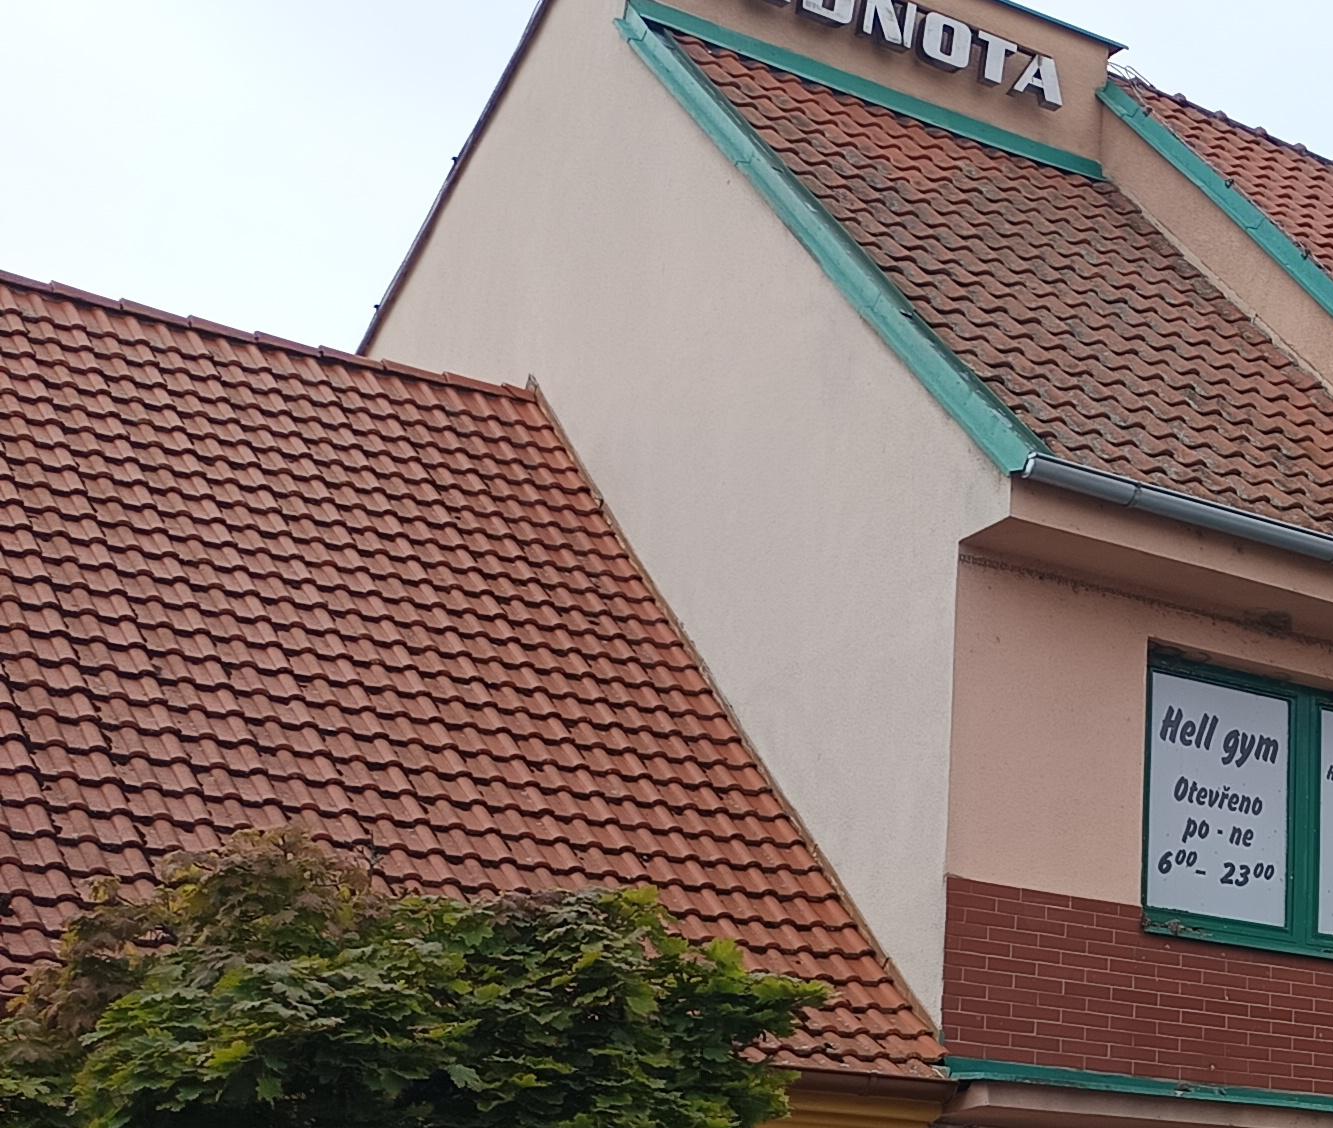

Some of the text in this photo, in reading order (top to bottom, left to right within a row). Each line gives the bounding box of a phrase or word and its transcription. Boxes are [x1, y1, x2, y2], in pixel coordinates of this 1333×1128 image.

[785, 0, 1063, 107] NOTA
[1160, 706, 1279, 767] Hell gym
[1173, 776, 1263, 816] Otevřeno
[1182, 817, 1210, 843] po
[1229, 824, 1254, 847] ne
